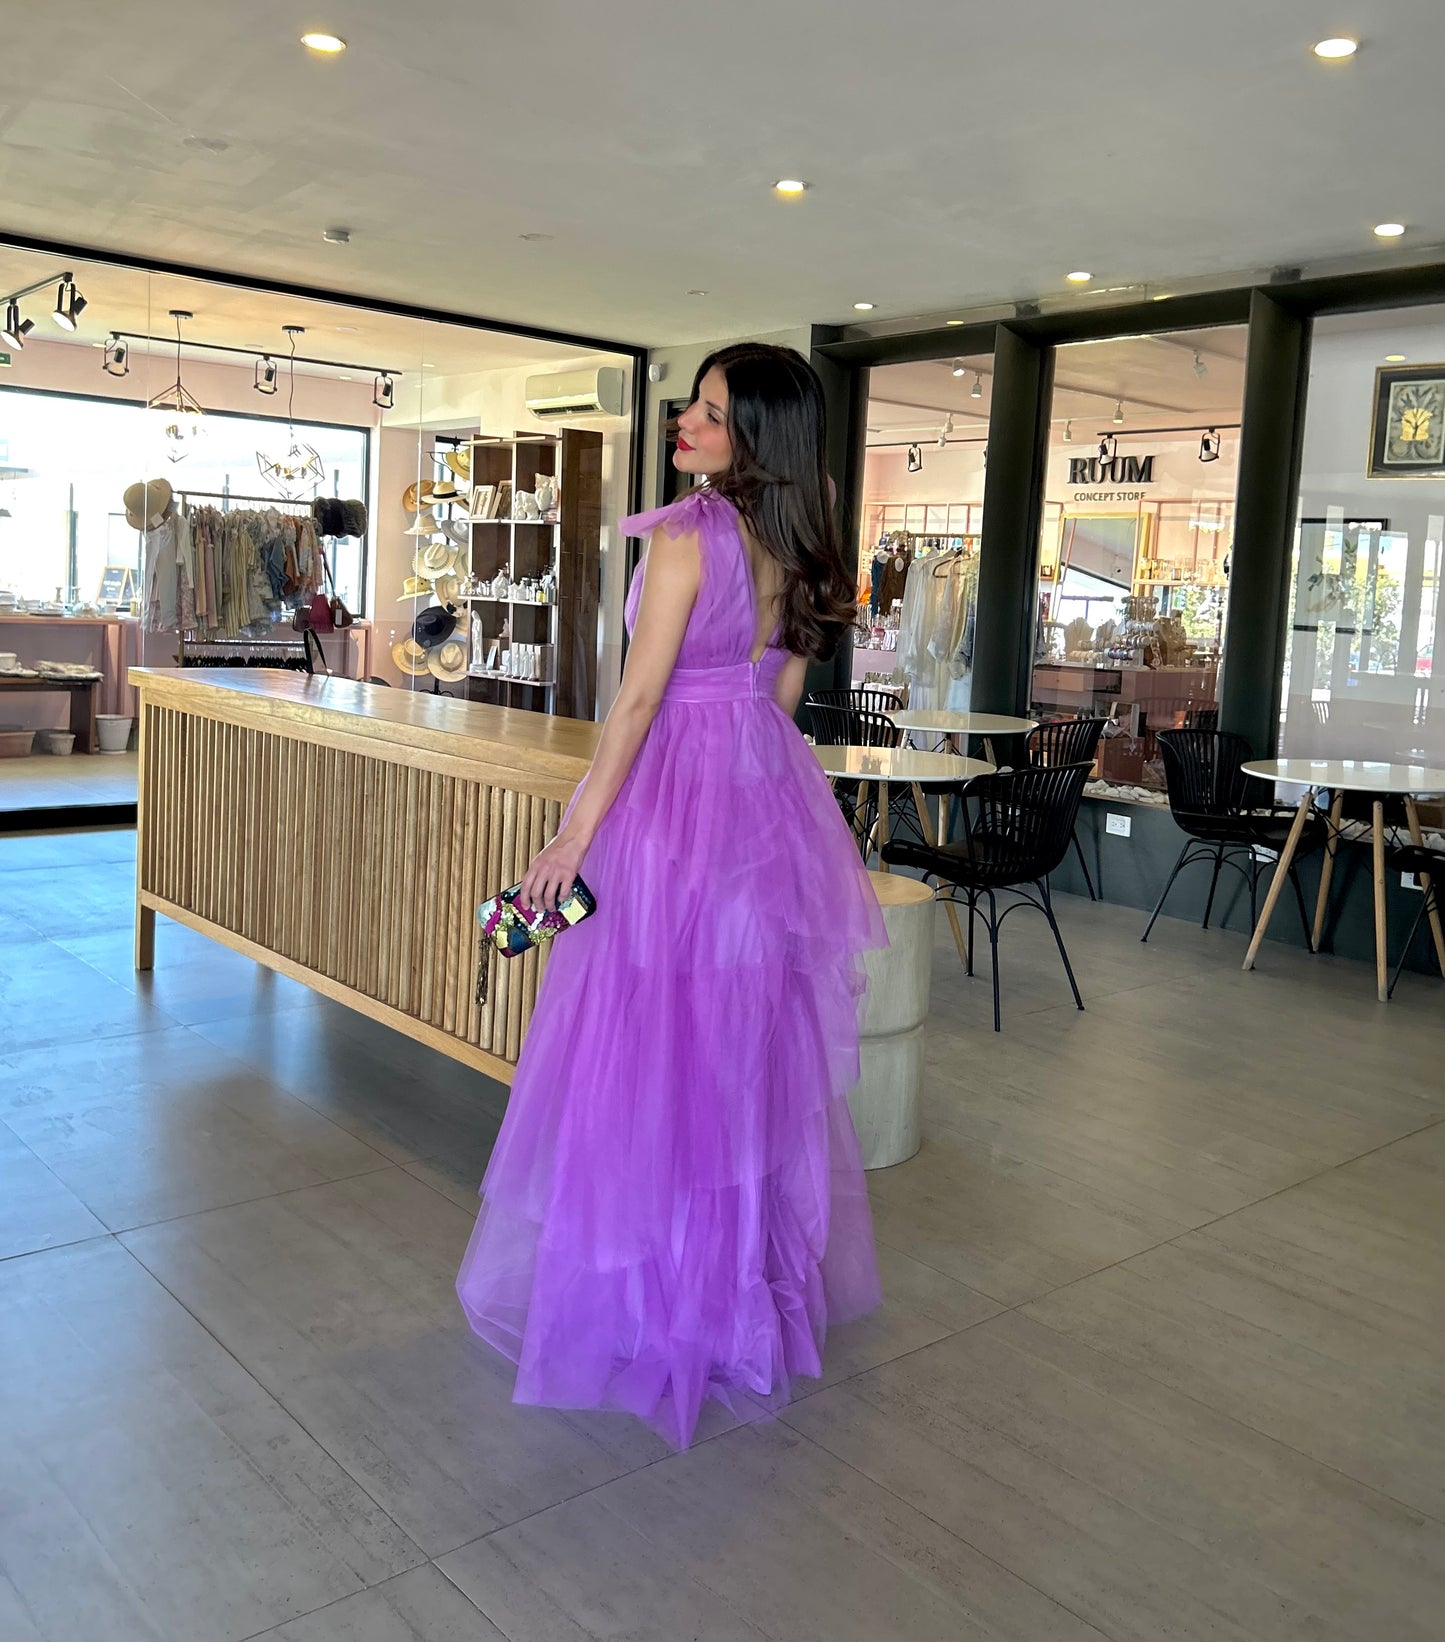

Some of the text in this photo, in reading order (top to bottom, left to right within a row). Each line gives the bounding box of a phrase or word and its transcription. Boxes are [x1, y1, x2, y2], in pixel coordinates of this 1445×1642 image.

[1067, 456, 1155, 484] RUUM
[1074, 492, 1146, 501] CONCEPT STORE
